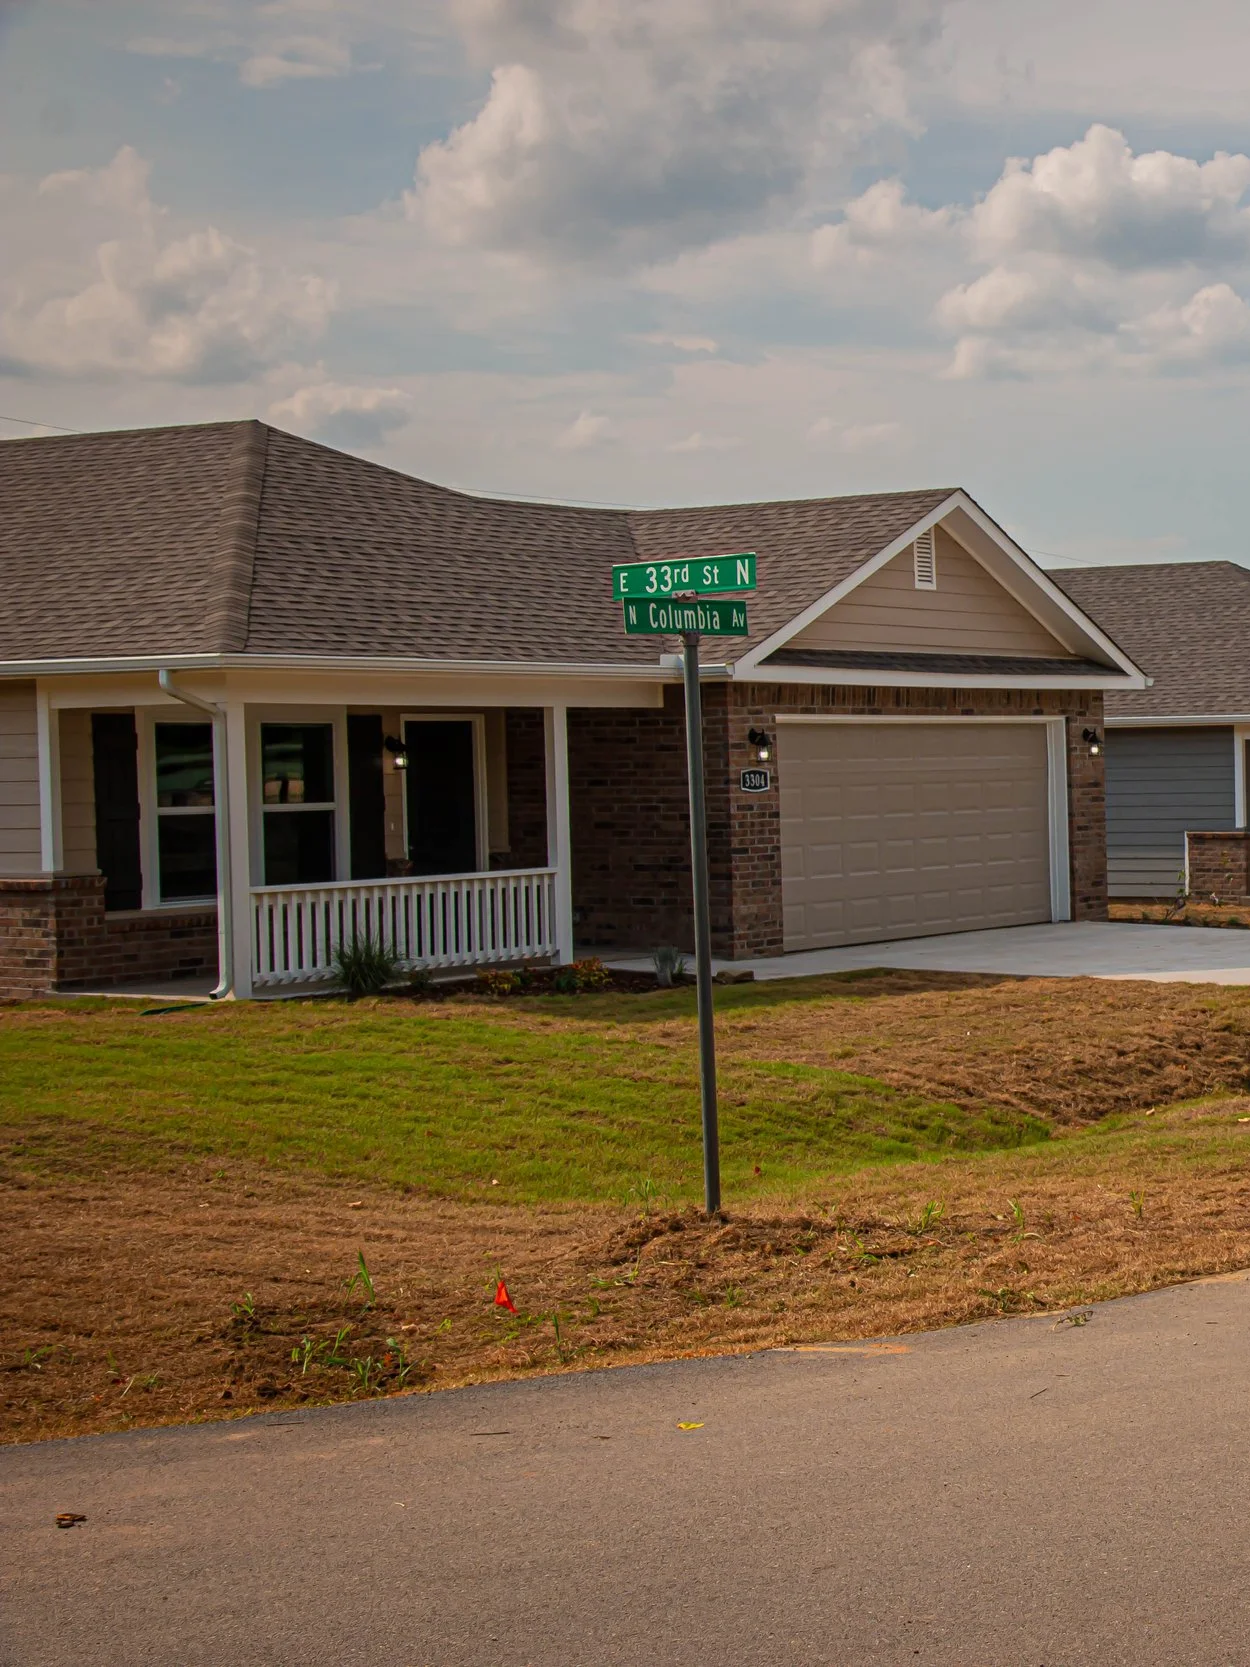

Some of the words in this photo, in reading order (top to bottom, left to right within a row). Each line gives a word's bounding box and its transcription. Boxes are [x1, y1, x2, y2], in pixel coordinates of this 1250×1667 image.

[620, 573, 628, 592] E
[646, 564, 689, 593] 33rd
[703, 566, 719, 584] St
[737, 559, 749, 585] N
[629, 605, 637, 624] N
[650, 603, 720, 630] Columbia
[733, 609, 744, 628] Av
[745, 774, 765, 786] 3304
